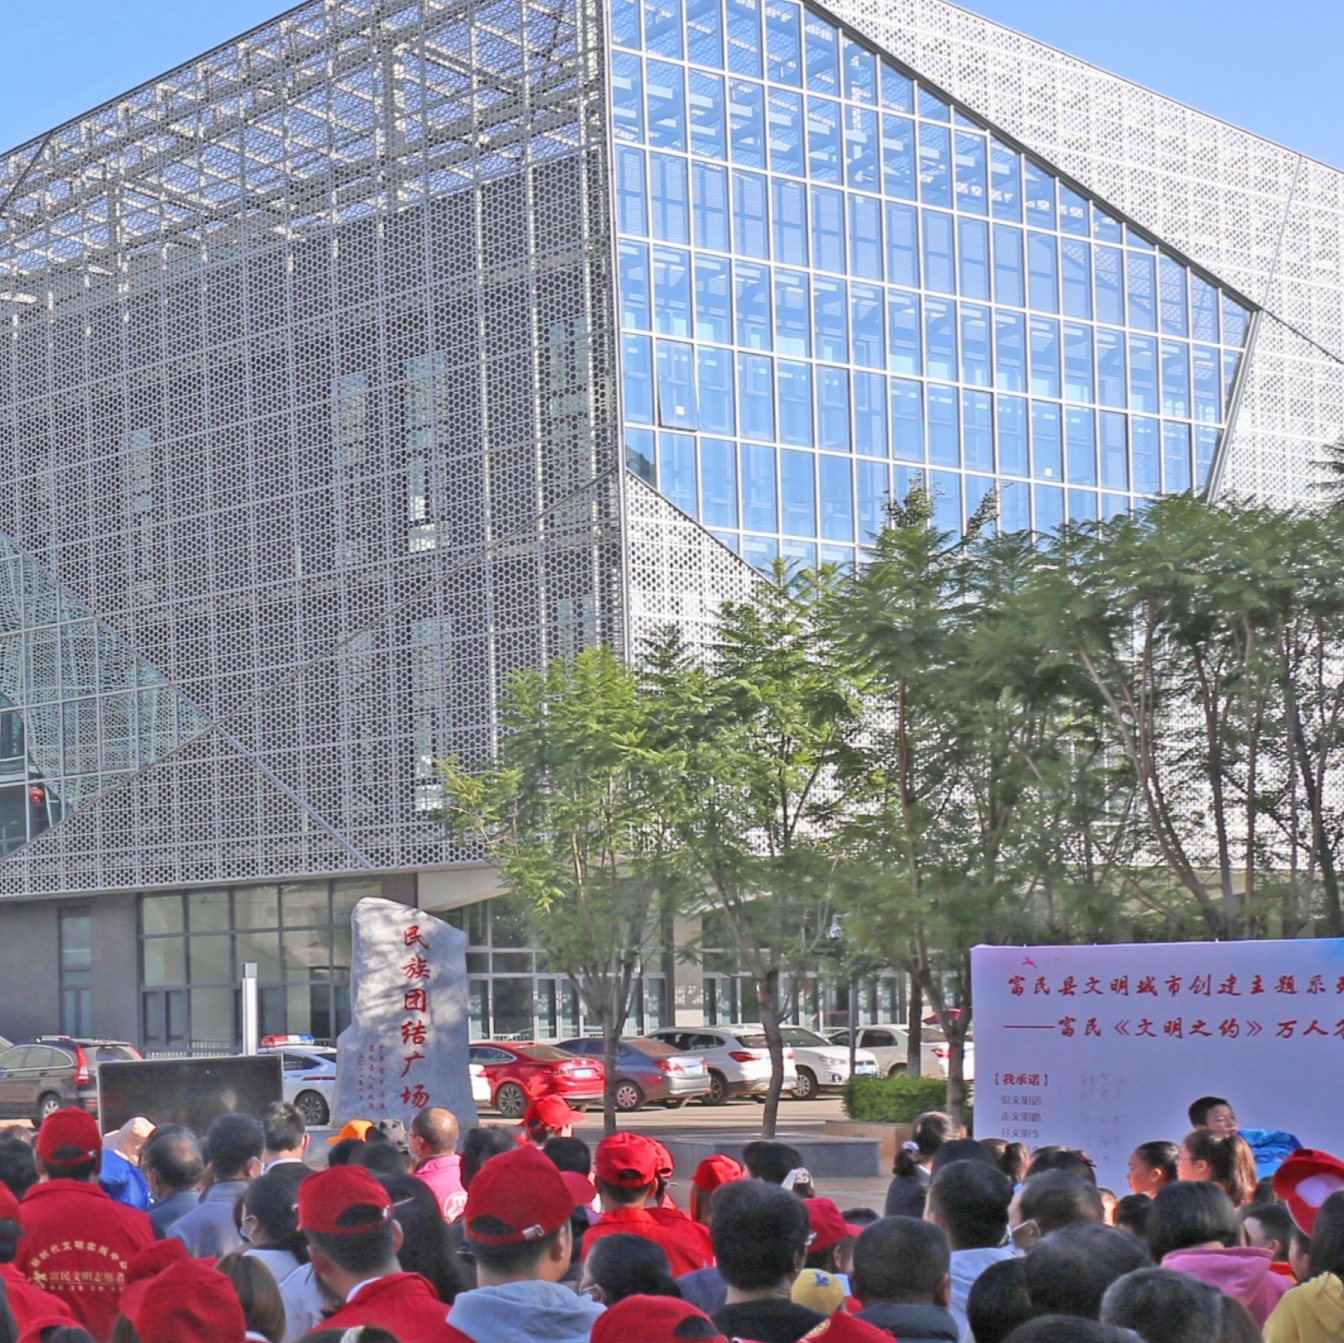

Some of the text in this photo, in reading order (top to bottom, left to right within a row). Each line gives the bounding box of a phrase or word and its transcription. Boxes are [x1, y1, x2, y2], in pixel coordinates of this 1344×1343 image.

[399, 924, 431, 1109] 民族团结广场
